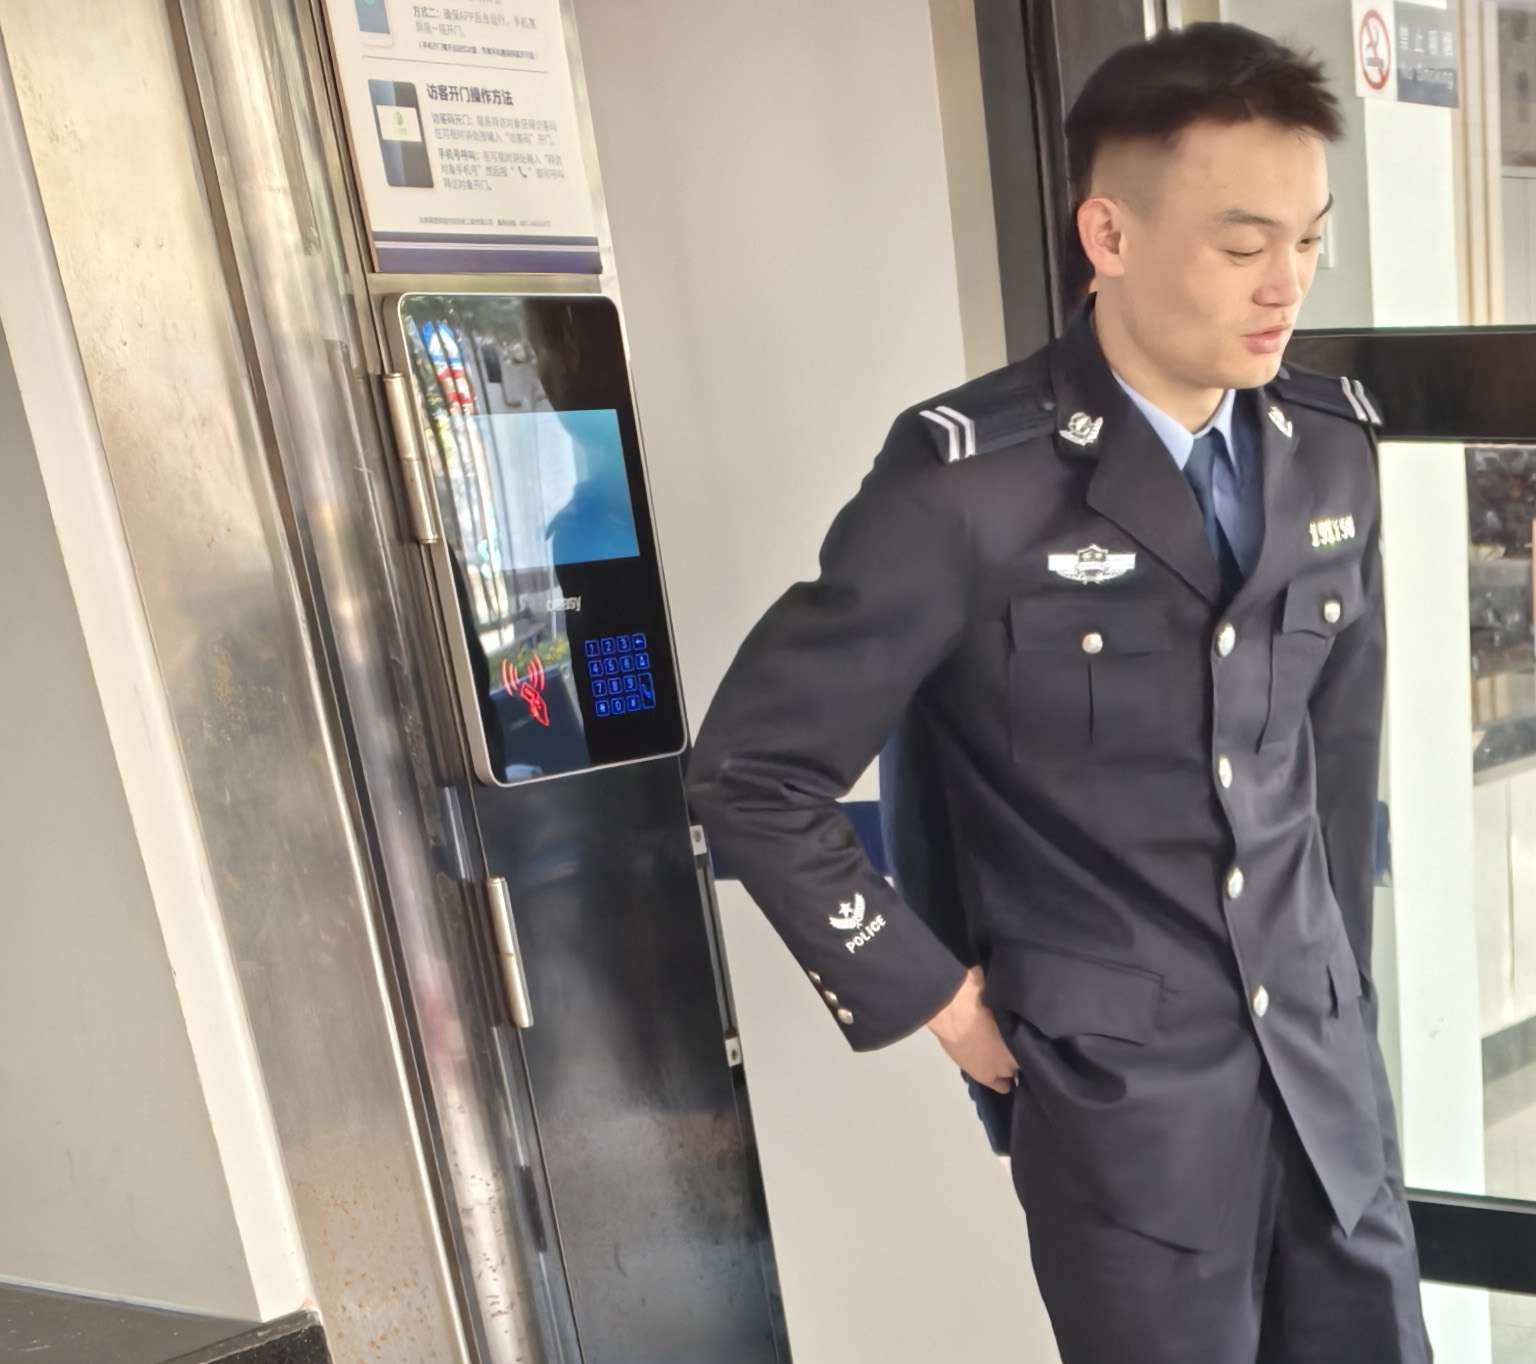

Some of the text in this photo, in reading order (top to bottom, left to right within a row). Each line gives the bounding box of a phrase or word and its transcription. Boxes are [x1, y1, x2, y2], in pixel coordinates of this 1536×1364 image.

[426, 83, 515, 106] 访客开门操作方法
[845, 914, 887, 953] POLICE
